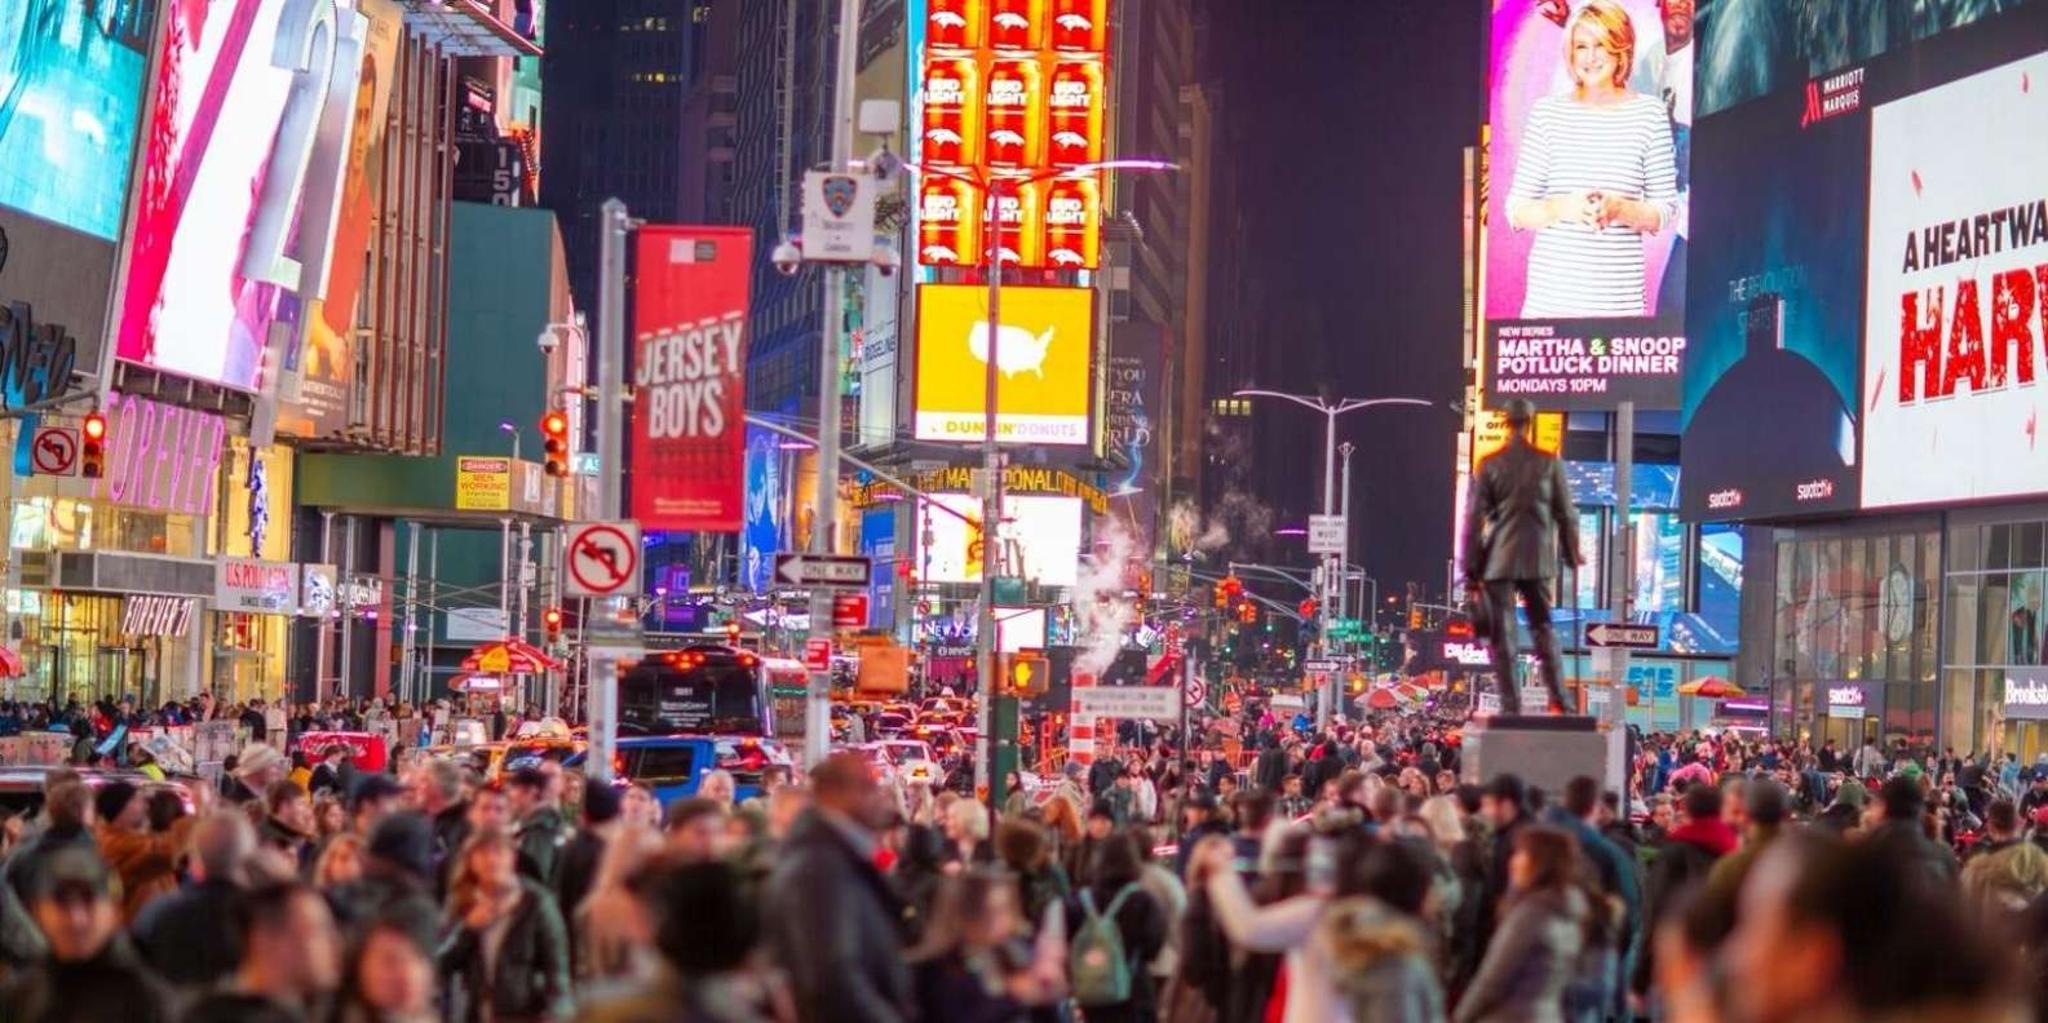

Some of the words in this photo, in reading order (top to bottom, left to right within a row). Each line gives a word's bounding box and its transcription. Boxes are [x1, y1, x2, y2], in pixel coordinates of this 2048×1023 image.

[1903, 231, 1919, 274] A
[1498, 327, 1520, 337] NEW
[1898, 263, 2048, 403] HAR
[636, 321, 743, 386] JERSEY
[1498, 339, 1585, 357] MARTHA
[1590, 338, 1606, 356] &
[1611, 337, 1687, 356] SNOOP
[1498, 357, 1593, 374] POTLUCK
[1598, 355, 1680, 373] DINNER
[1498, 379, 1567, 393] MONDAYS
[1570, 378, 1607, 392] 10PM
[649, 379, 724, 438] BOYS
[835, 565, 860, 575] WAY
